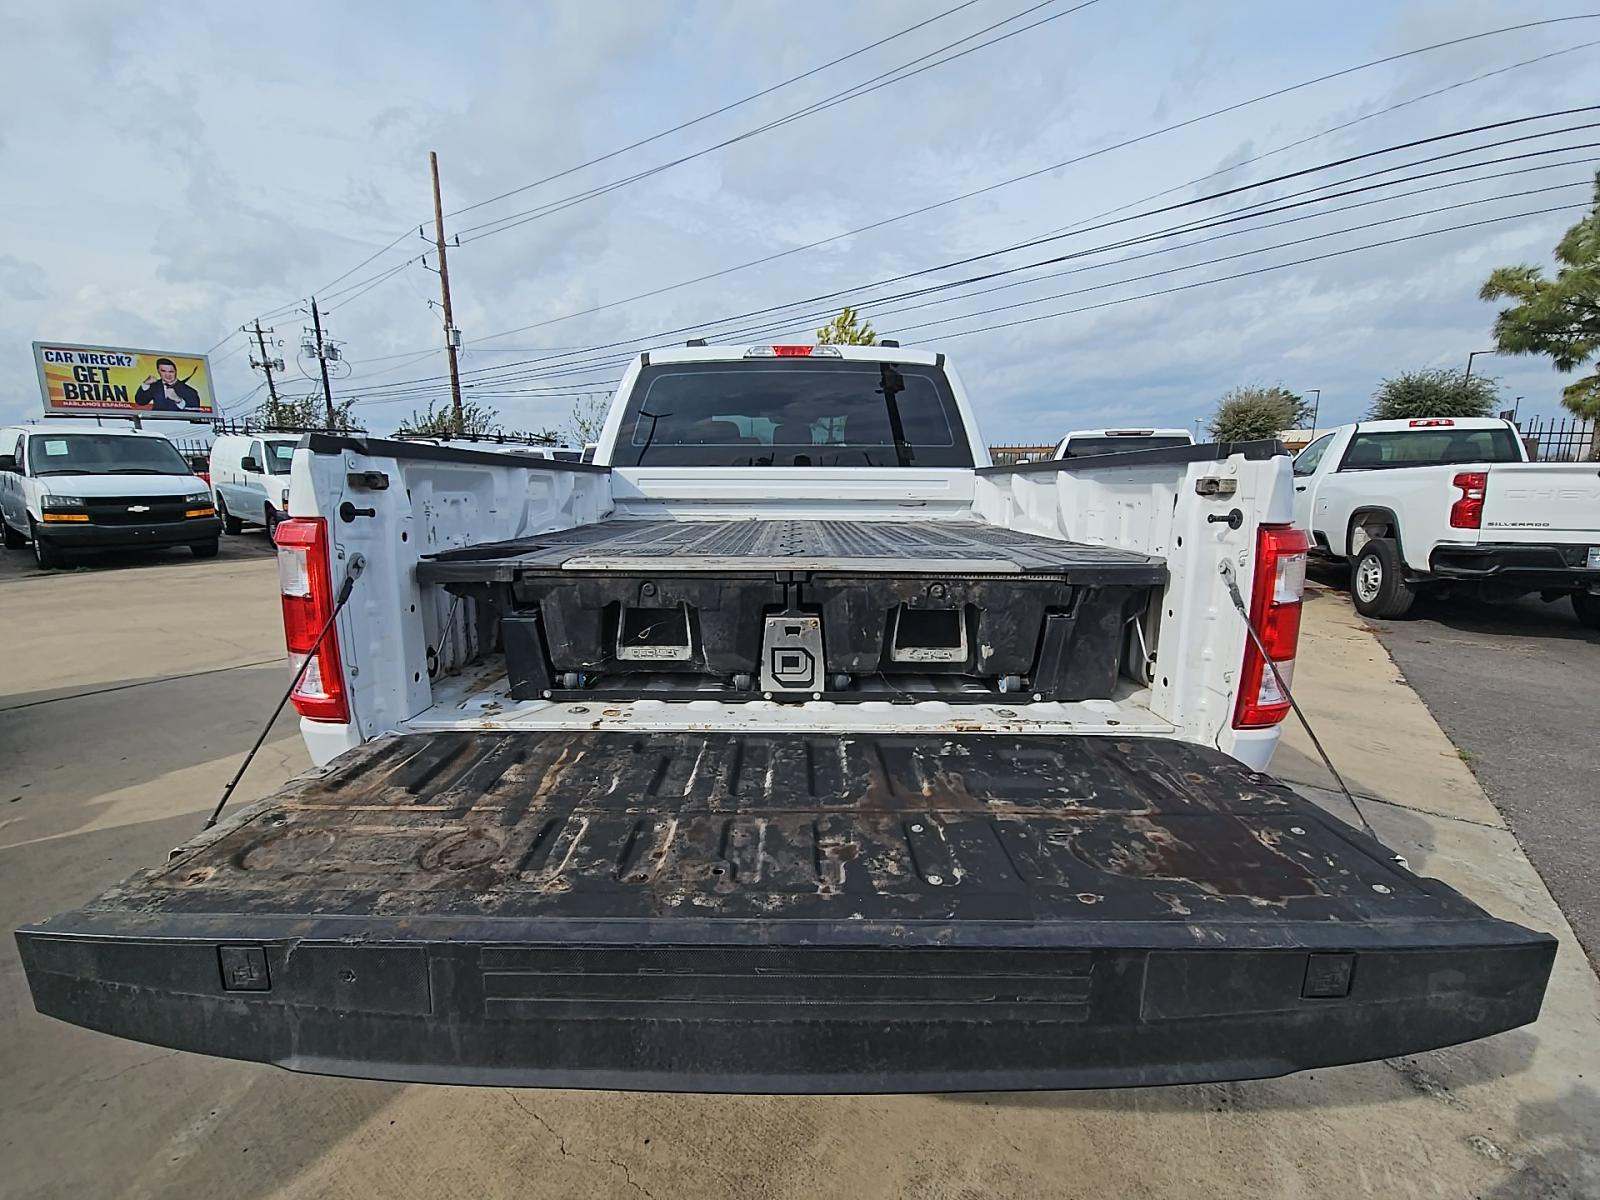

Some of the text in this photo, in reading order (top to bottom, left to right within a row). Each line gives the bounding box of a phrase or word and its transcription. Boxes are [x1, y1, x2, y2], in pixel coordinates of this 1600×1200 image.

[45, 351, 132, 367] CAR WRECK?
[73, 366, 110, 384] GET
[63, 383, 129, 401] BRIAN
